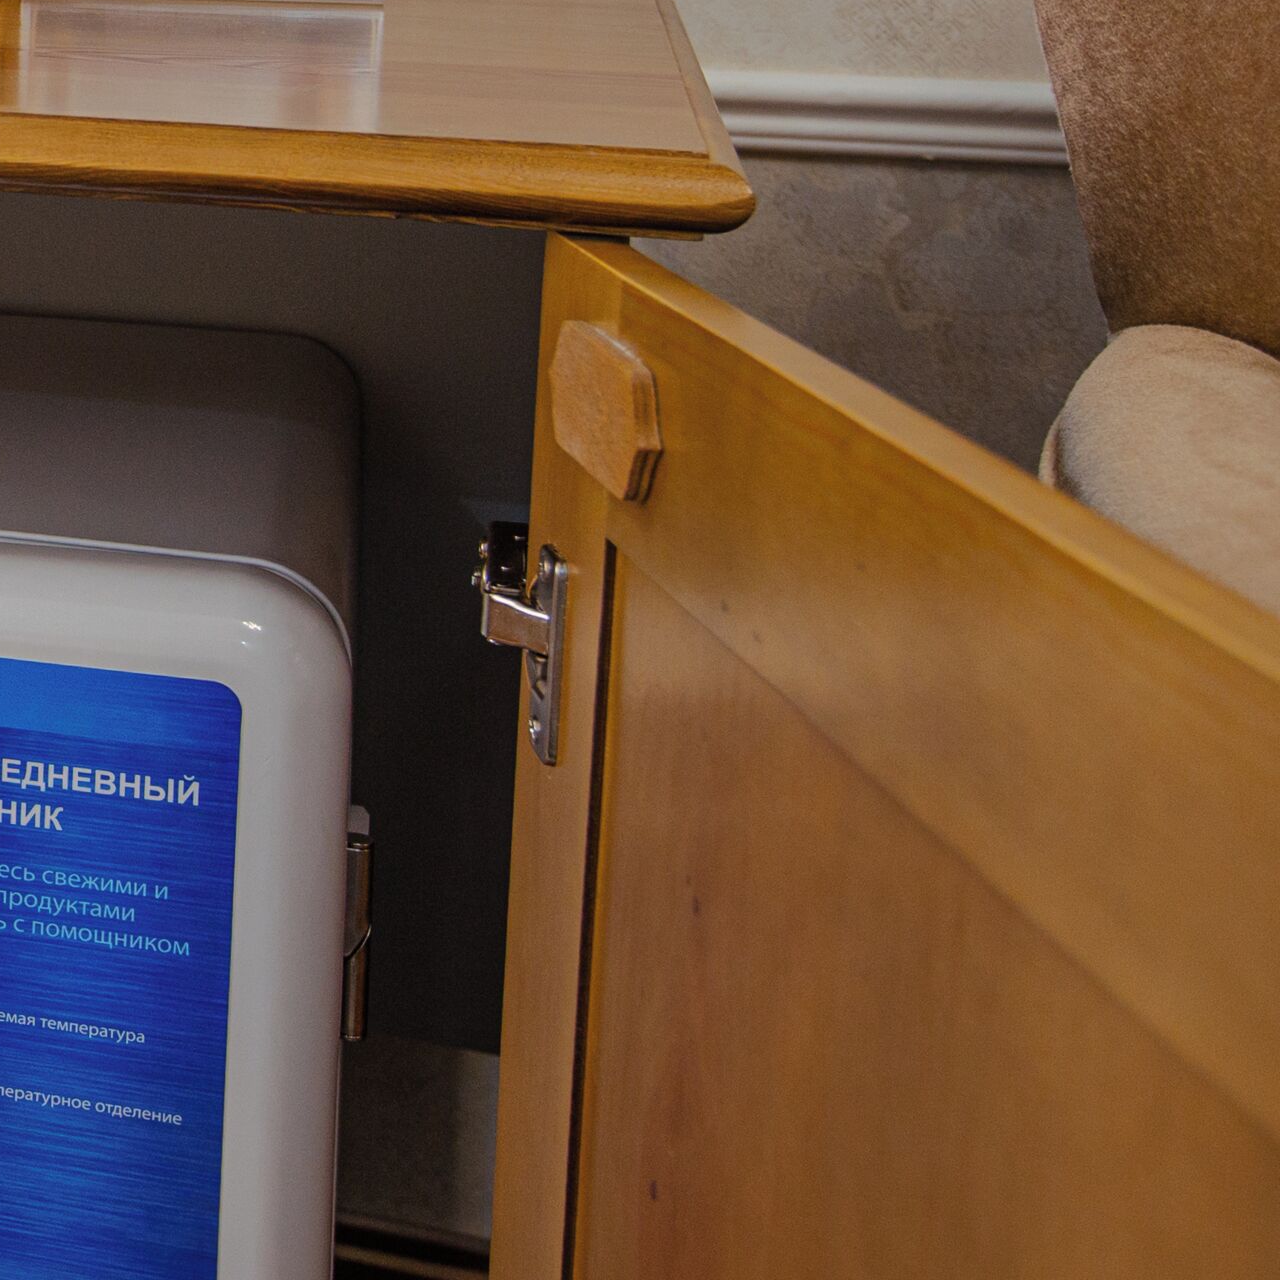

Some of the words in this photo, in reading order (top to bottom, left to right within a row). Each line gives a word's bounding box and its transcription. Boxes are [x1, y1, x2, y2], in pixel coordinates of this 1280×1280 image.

[41, 866, 147, 897] свежими
[154, 884, 169, 900] и
[13, 919, 26, 933] с
[32, 921, 191, 957] помощником
[40, 1018, 146, 1046] температура
[95, 1098, 183, 1126] отделение
